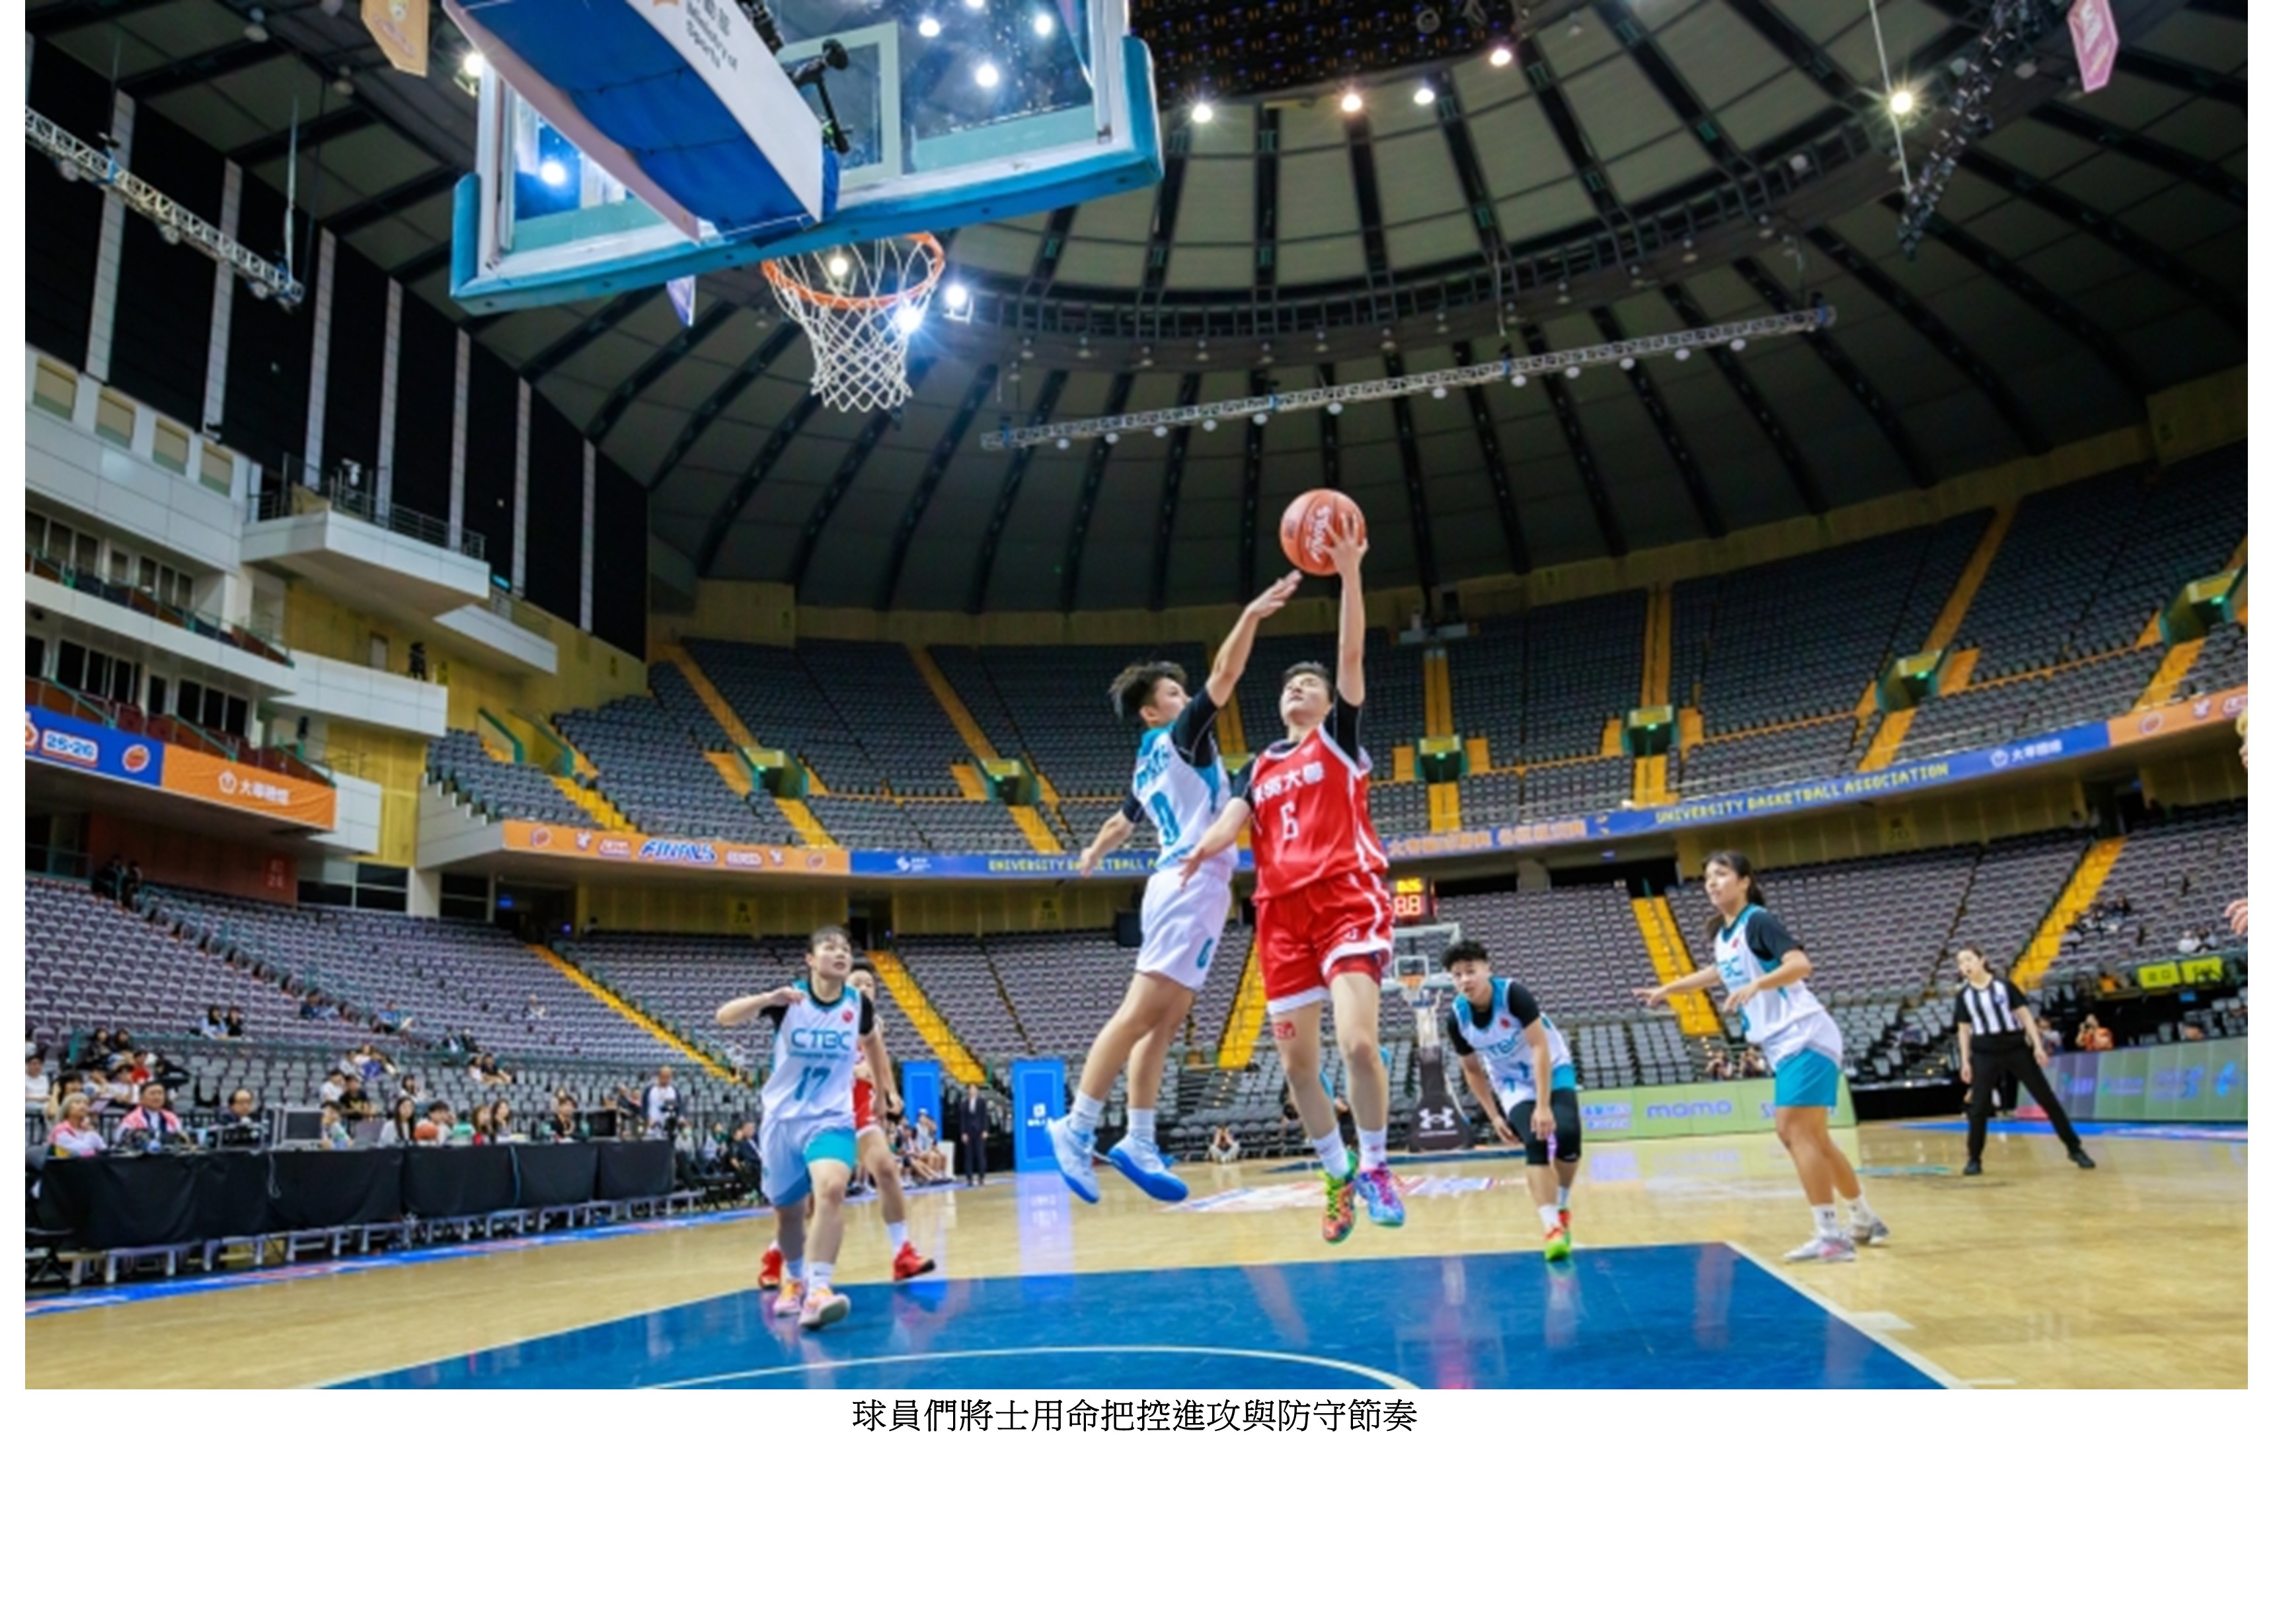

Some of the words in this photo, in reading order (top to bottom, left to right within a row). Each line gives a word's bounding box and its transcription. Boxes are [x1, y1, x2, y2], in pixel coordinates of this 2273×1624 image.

[1656, 800, 1744, 824] UNIVERSITY
[1748, 785, 1840, 811] BASKETBALL
[1844, 763, 1949, 794] ASSOCIATION
[988, 857, 1065, 872] UNIVERSITY
[791, 1028, 852, 1050] CTBC
[794, 1066, 831, 1101] 17
[1646, 1099, 1732, 1119] momo
